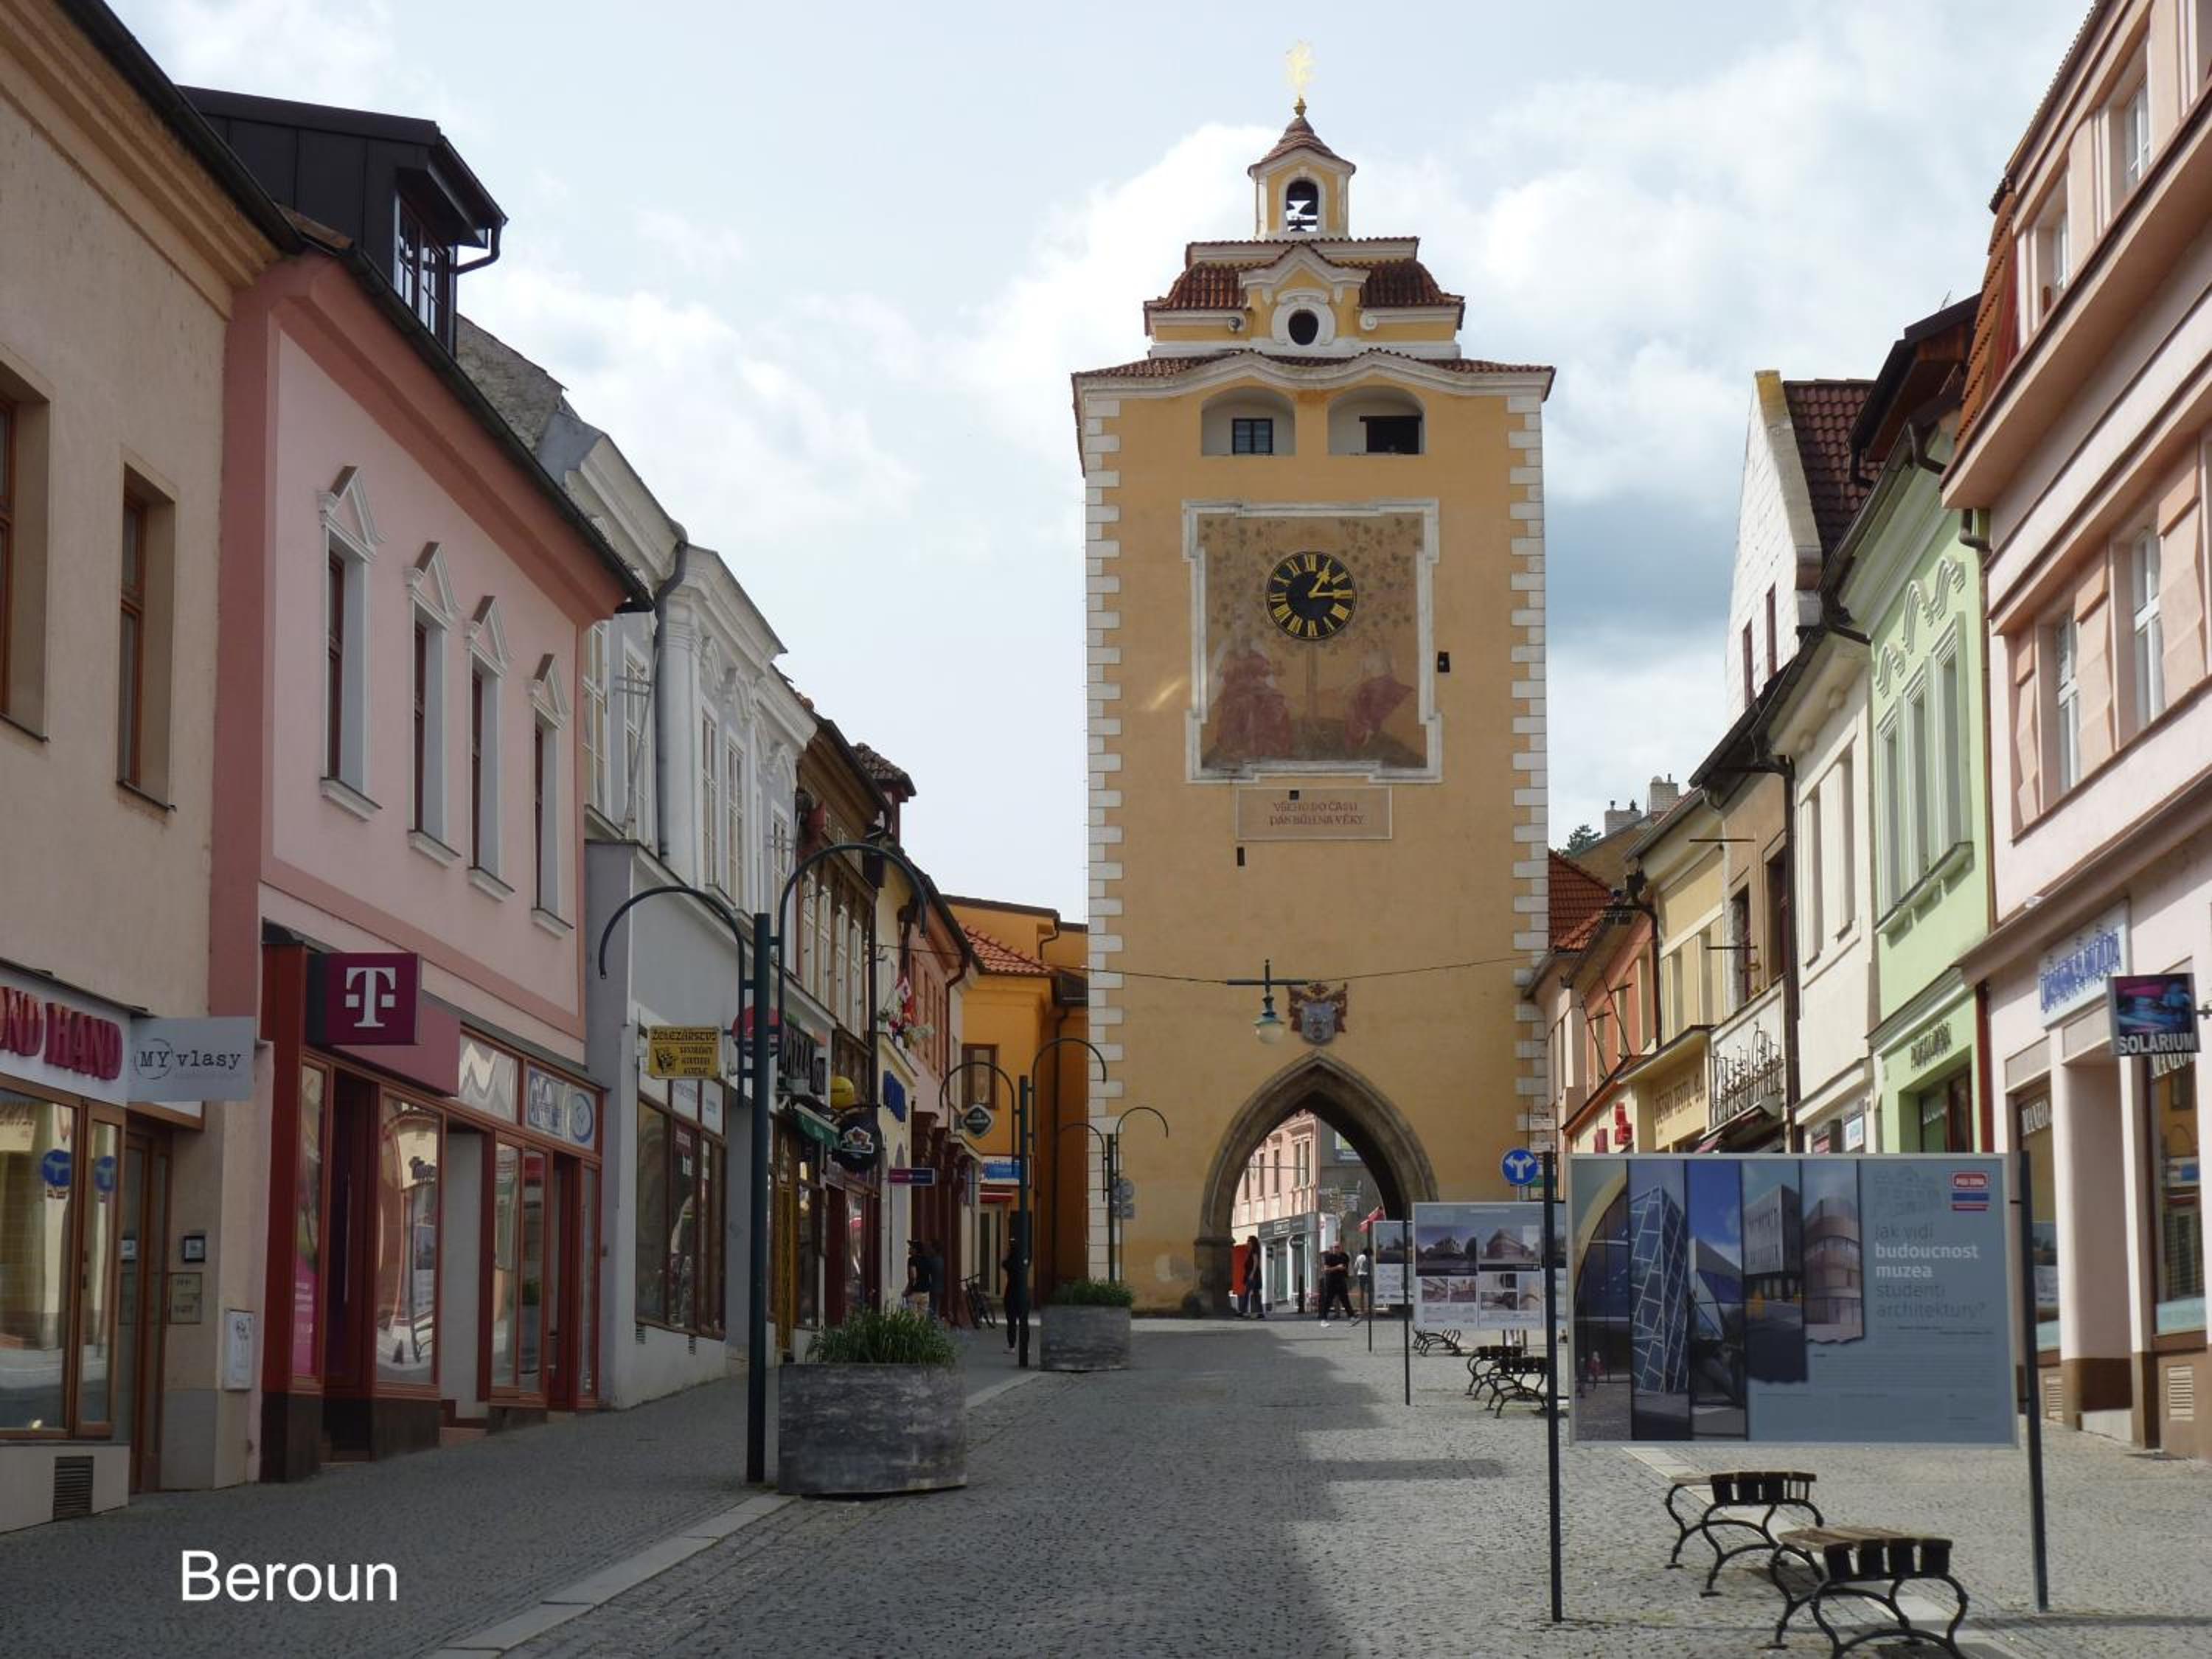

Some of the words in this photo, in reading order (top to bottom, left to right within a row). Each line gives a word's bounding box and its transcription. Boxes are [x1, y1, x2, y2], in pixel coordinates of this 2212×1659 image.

[345, 967, 396, 1027] T
[44, 1002, 123, 1081] HAND
[140, 1051, 172, 1068] MY
[176, 1050, 241, 1070] vlasy
[1875, 1242, 1979, 1259] budoucnost
[1875, 1265, 1933, 1279] muzea
[1875, 1282, 1946, 1298] studenti
[1875, 1301, 1986, 1320] architektury?
